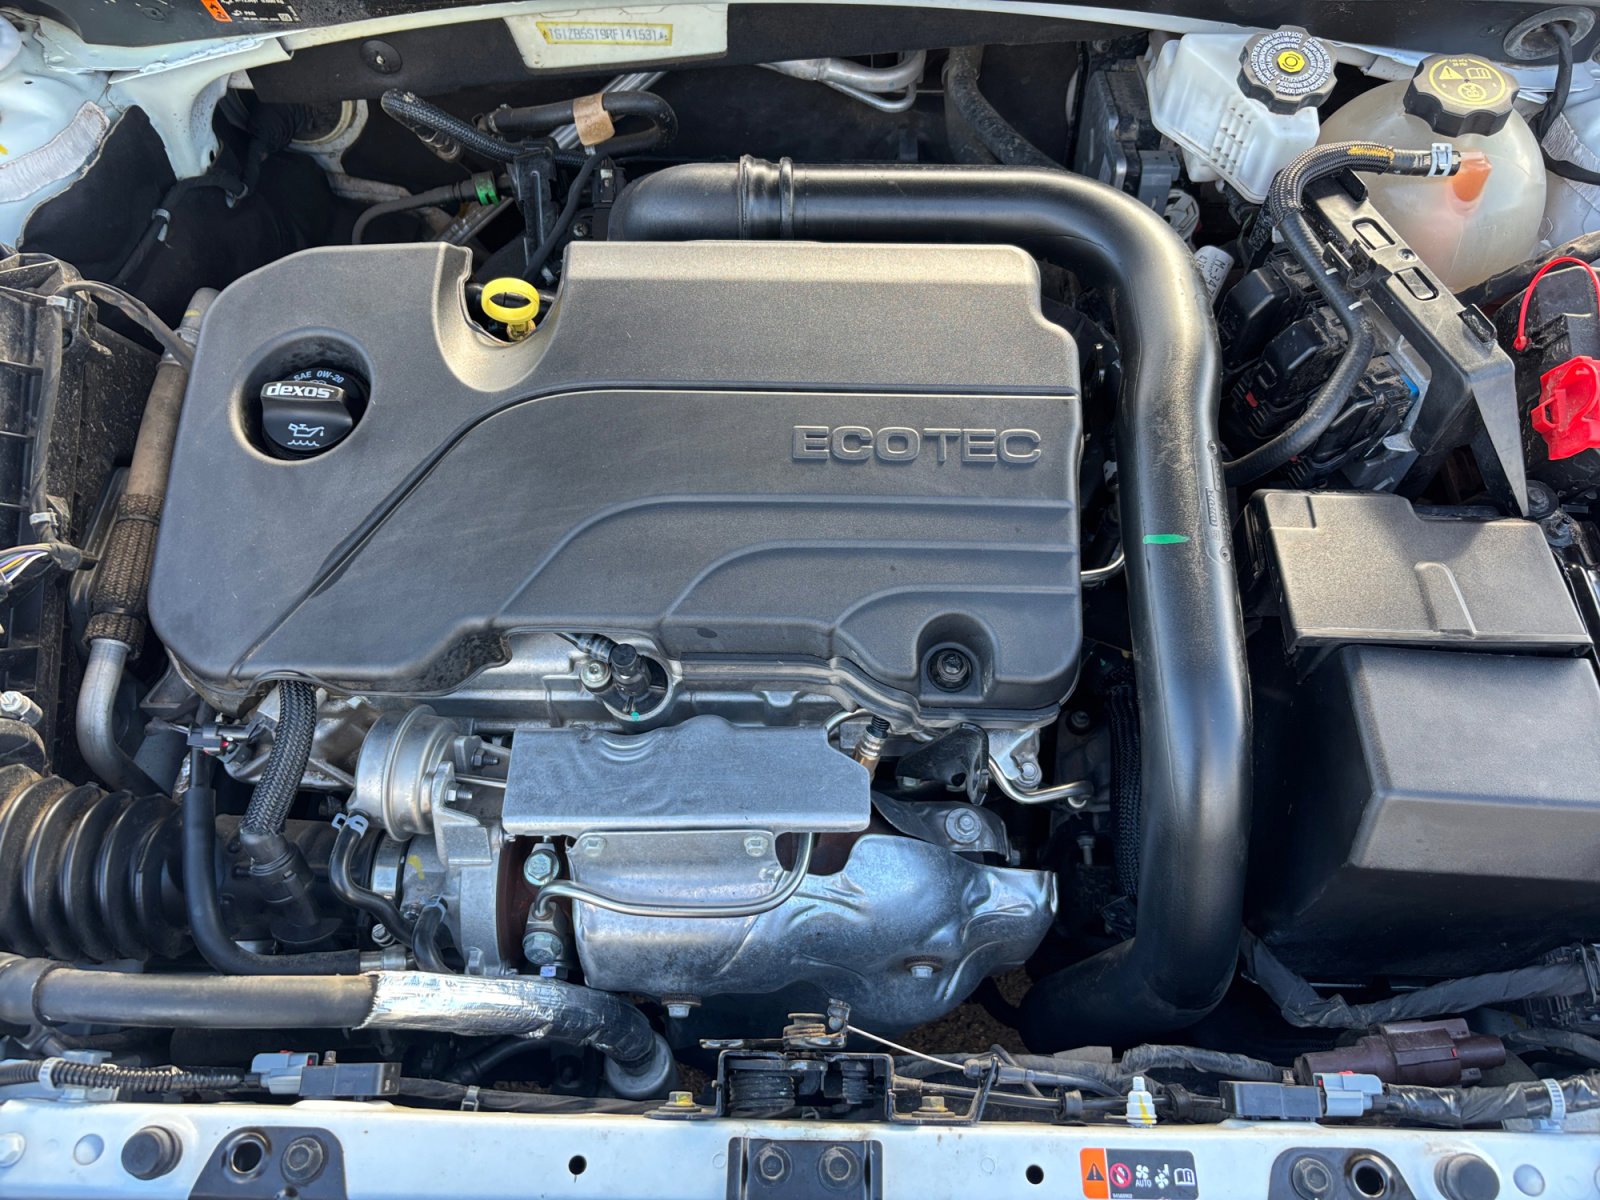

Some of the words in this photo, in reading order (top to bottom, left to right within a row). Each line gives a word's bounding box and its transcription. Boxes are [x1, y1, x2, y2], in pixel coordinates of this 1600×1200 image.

[293, 370, 312, 381] SAE
[316, 370, 344, 384] 0W-20
[266, 382, 334, 398] dexos
[792, 426, 1041, 463] ECOTEC
[1136, 1179, 1152, 1188] AUTO
